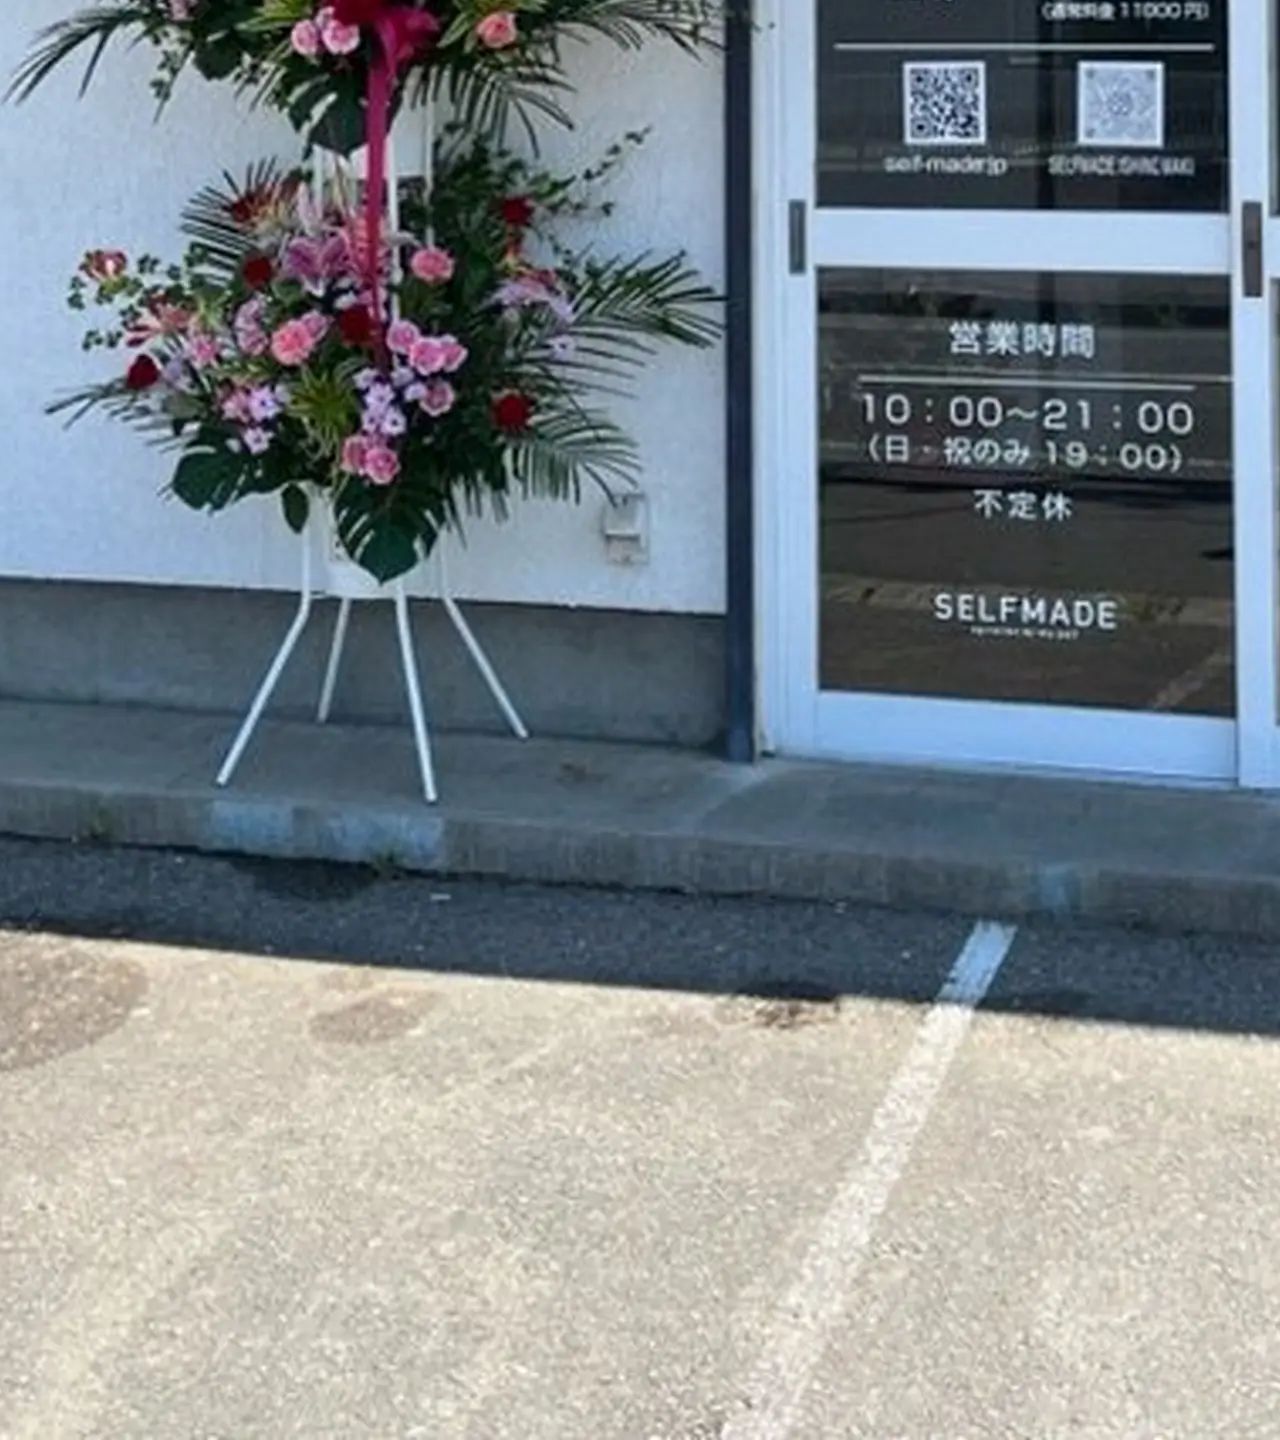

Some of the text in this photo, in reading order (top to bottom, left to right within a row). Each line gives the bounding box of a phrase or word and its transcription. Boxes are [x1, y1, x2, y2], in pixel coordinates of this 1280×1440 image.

[948, 320, 1097, 359] 営業時間
[973, 489, 1074, 520] 不定休
[934, 593, 1118, 630] SELFMADE
